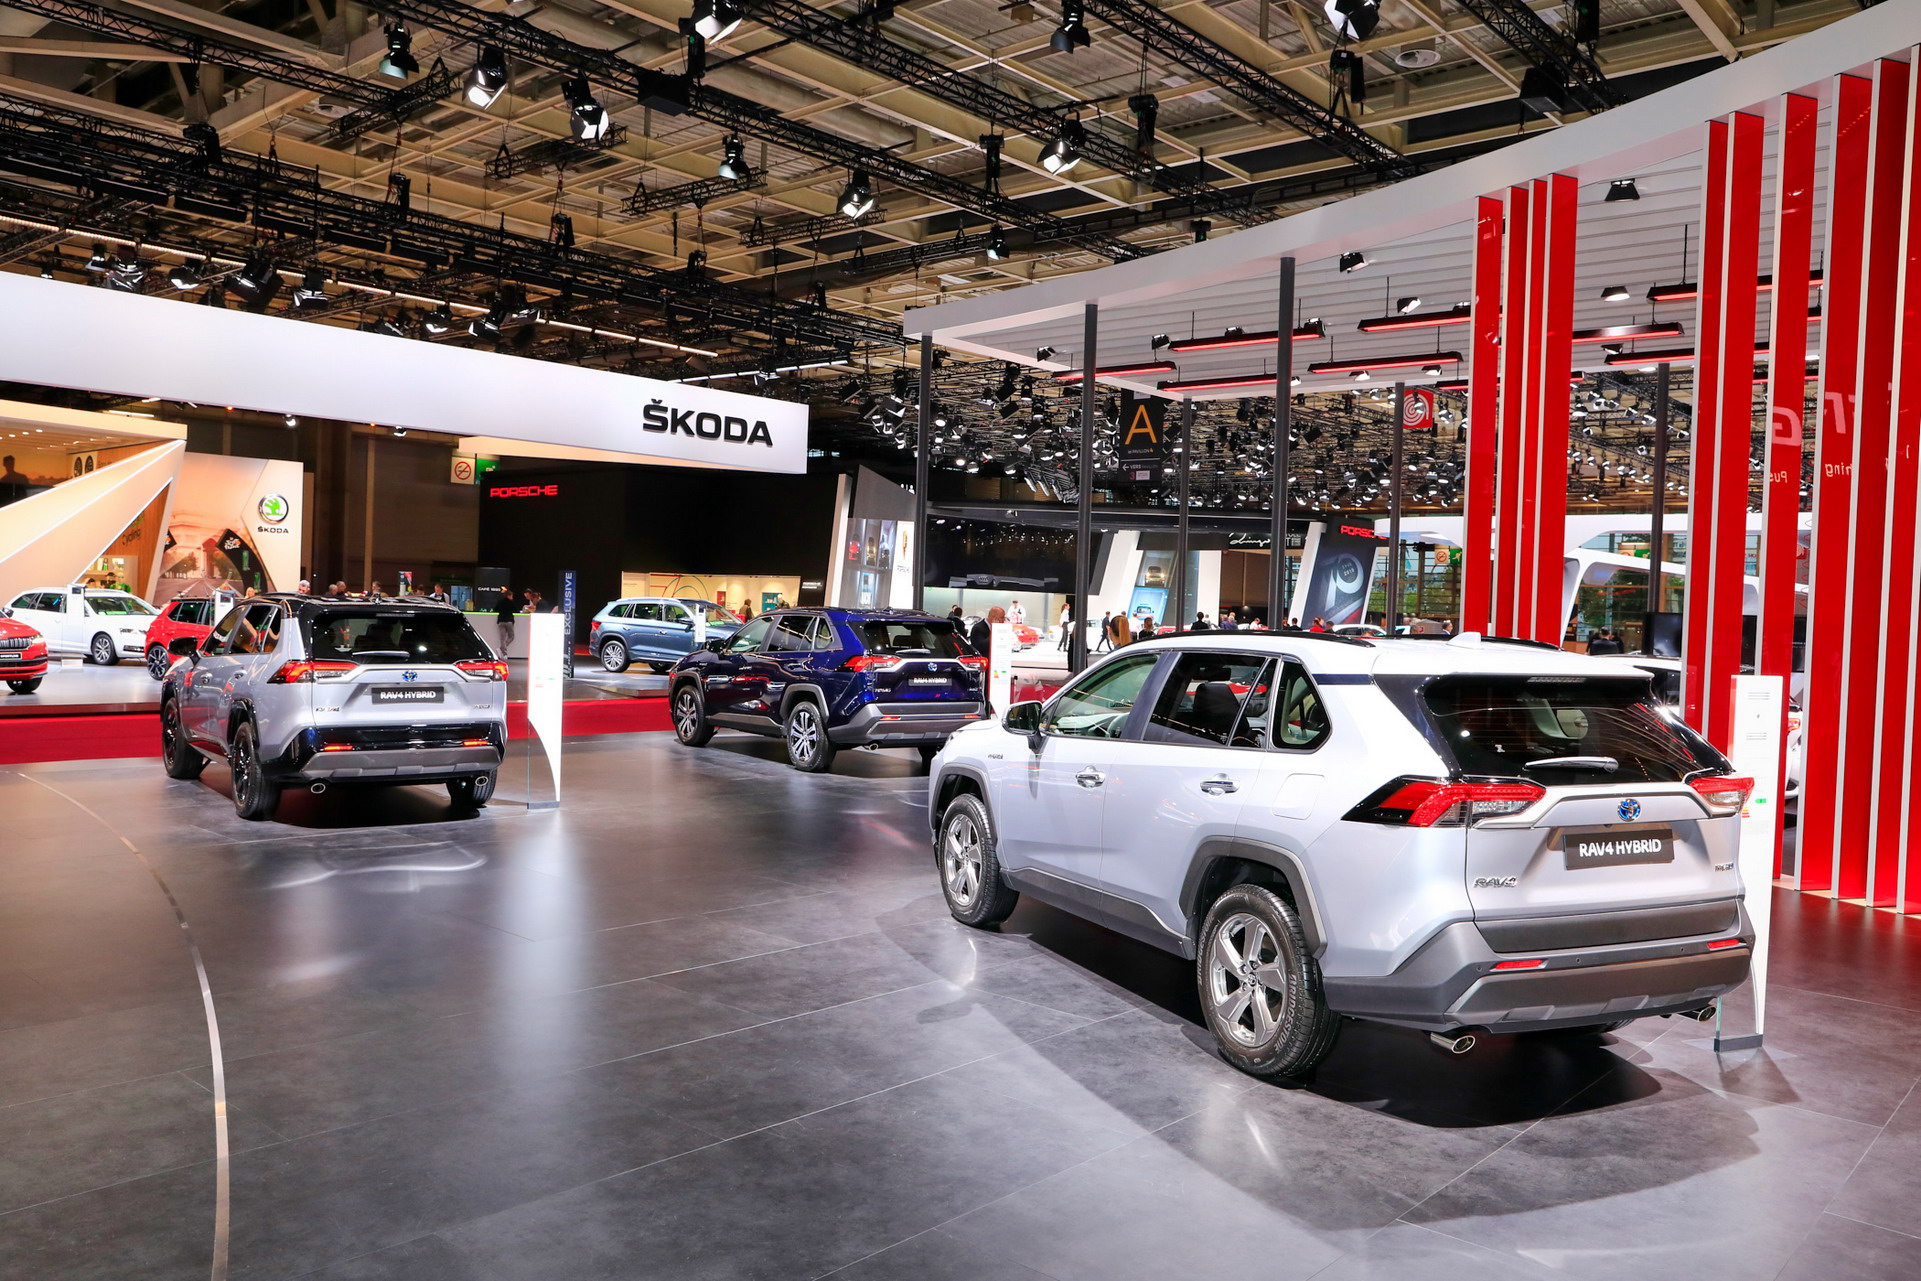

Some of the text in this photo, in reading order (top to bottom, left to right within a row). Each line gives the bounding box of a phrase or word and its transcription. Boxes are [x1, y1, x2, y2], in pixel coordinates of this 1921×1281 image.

[643, 398, 773, 448] ŠKODA
[1124, 404, 1157, 445] A
[490, 484, 559, 498] PORSCHE
[257, 525, 289, 534] ŠKODA
[563, 571, 573, 636] EXCLUSIVE
[380, 690, 437, 700] RAV4 HYBRID
[1579, 838, 1662, 857] RAV4 HYBRID
[1474, 877, 1518, 889] RAV4
[1273, 973, 1298, 1055] BRIDGESTONE
